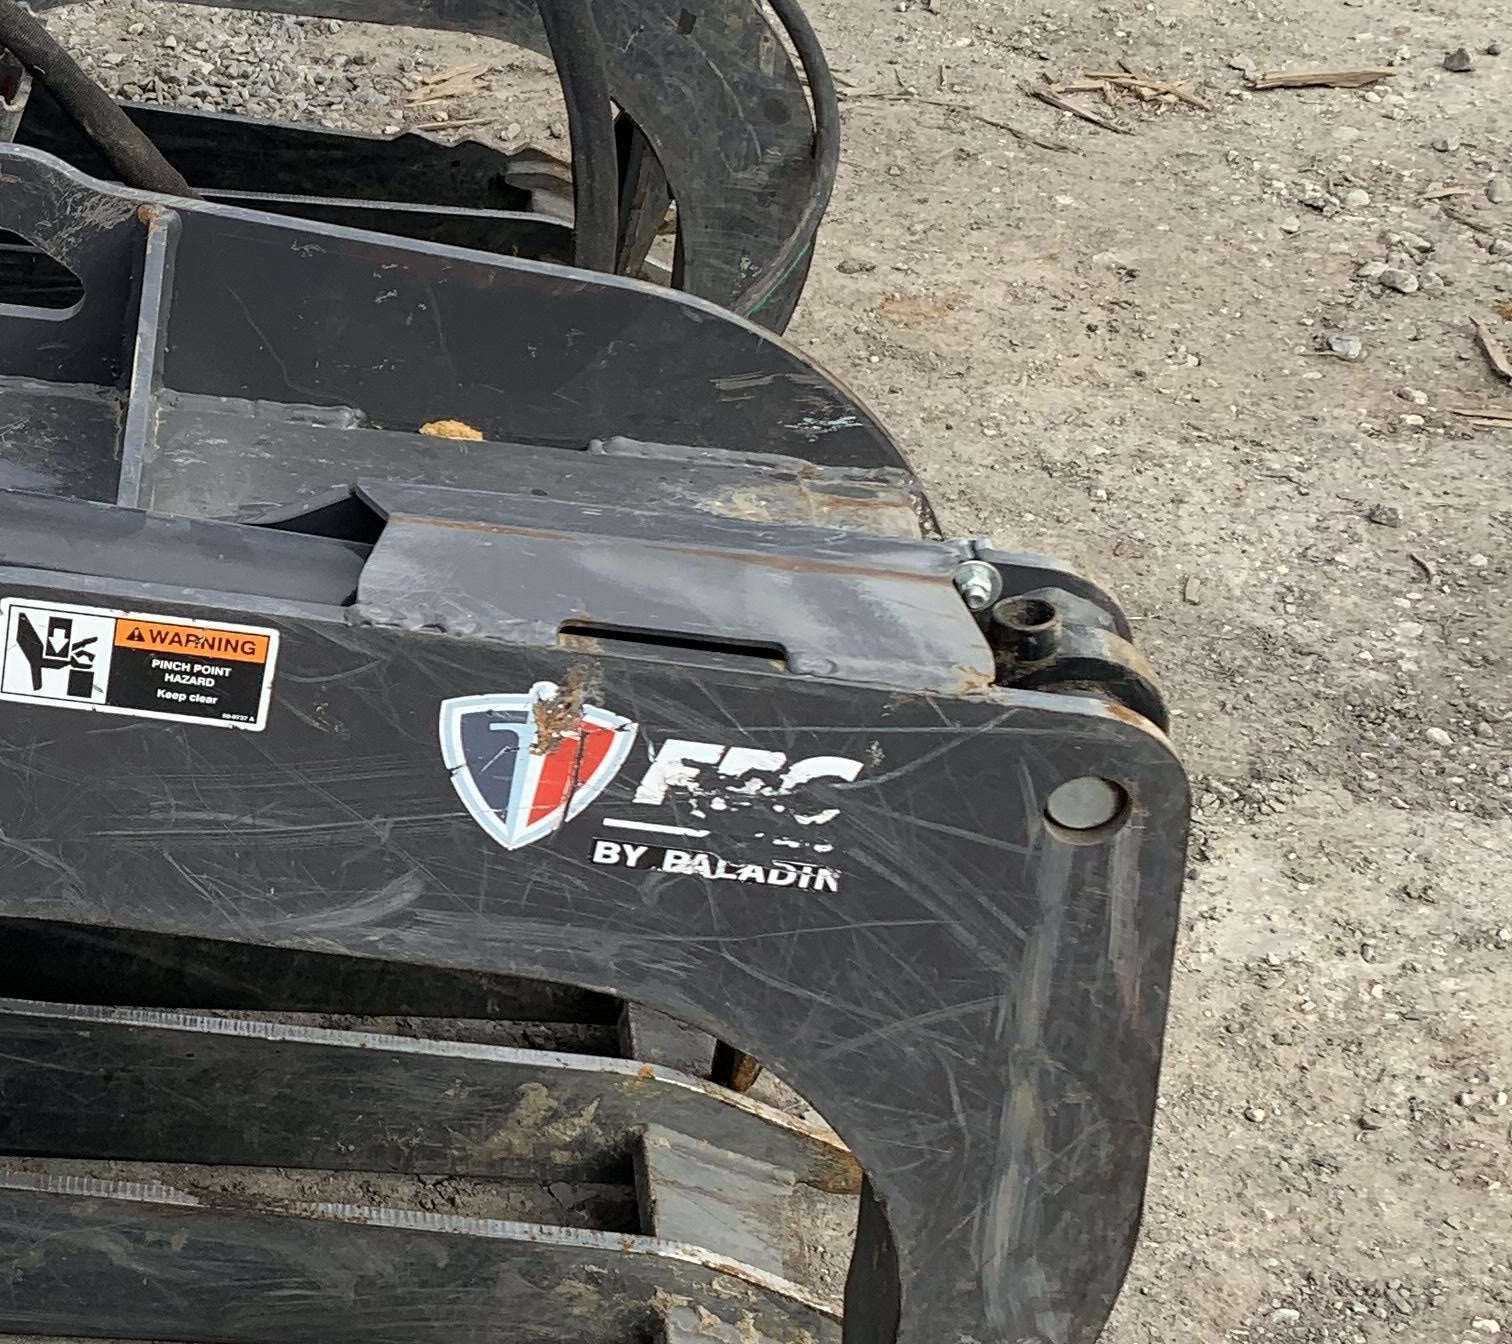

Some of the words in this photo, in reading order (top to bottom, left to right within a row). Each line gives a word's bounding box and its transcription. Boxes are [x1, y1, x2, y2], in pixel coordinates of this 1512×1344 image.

[149, 629, 257, 656] WARNING
[151, 658, 191, 673] PINCH
[193, 663, 232, 677] POINT
[164, 672, 215, 688] HAZARD
[156, 688, 187, 704] Keep
[189, 691, 218, 705] clear
[592, 840, 648, 867] BY
